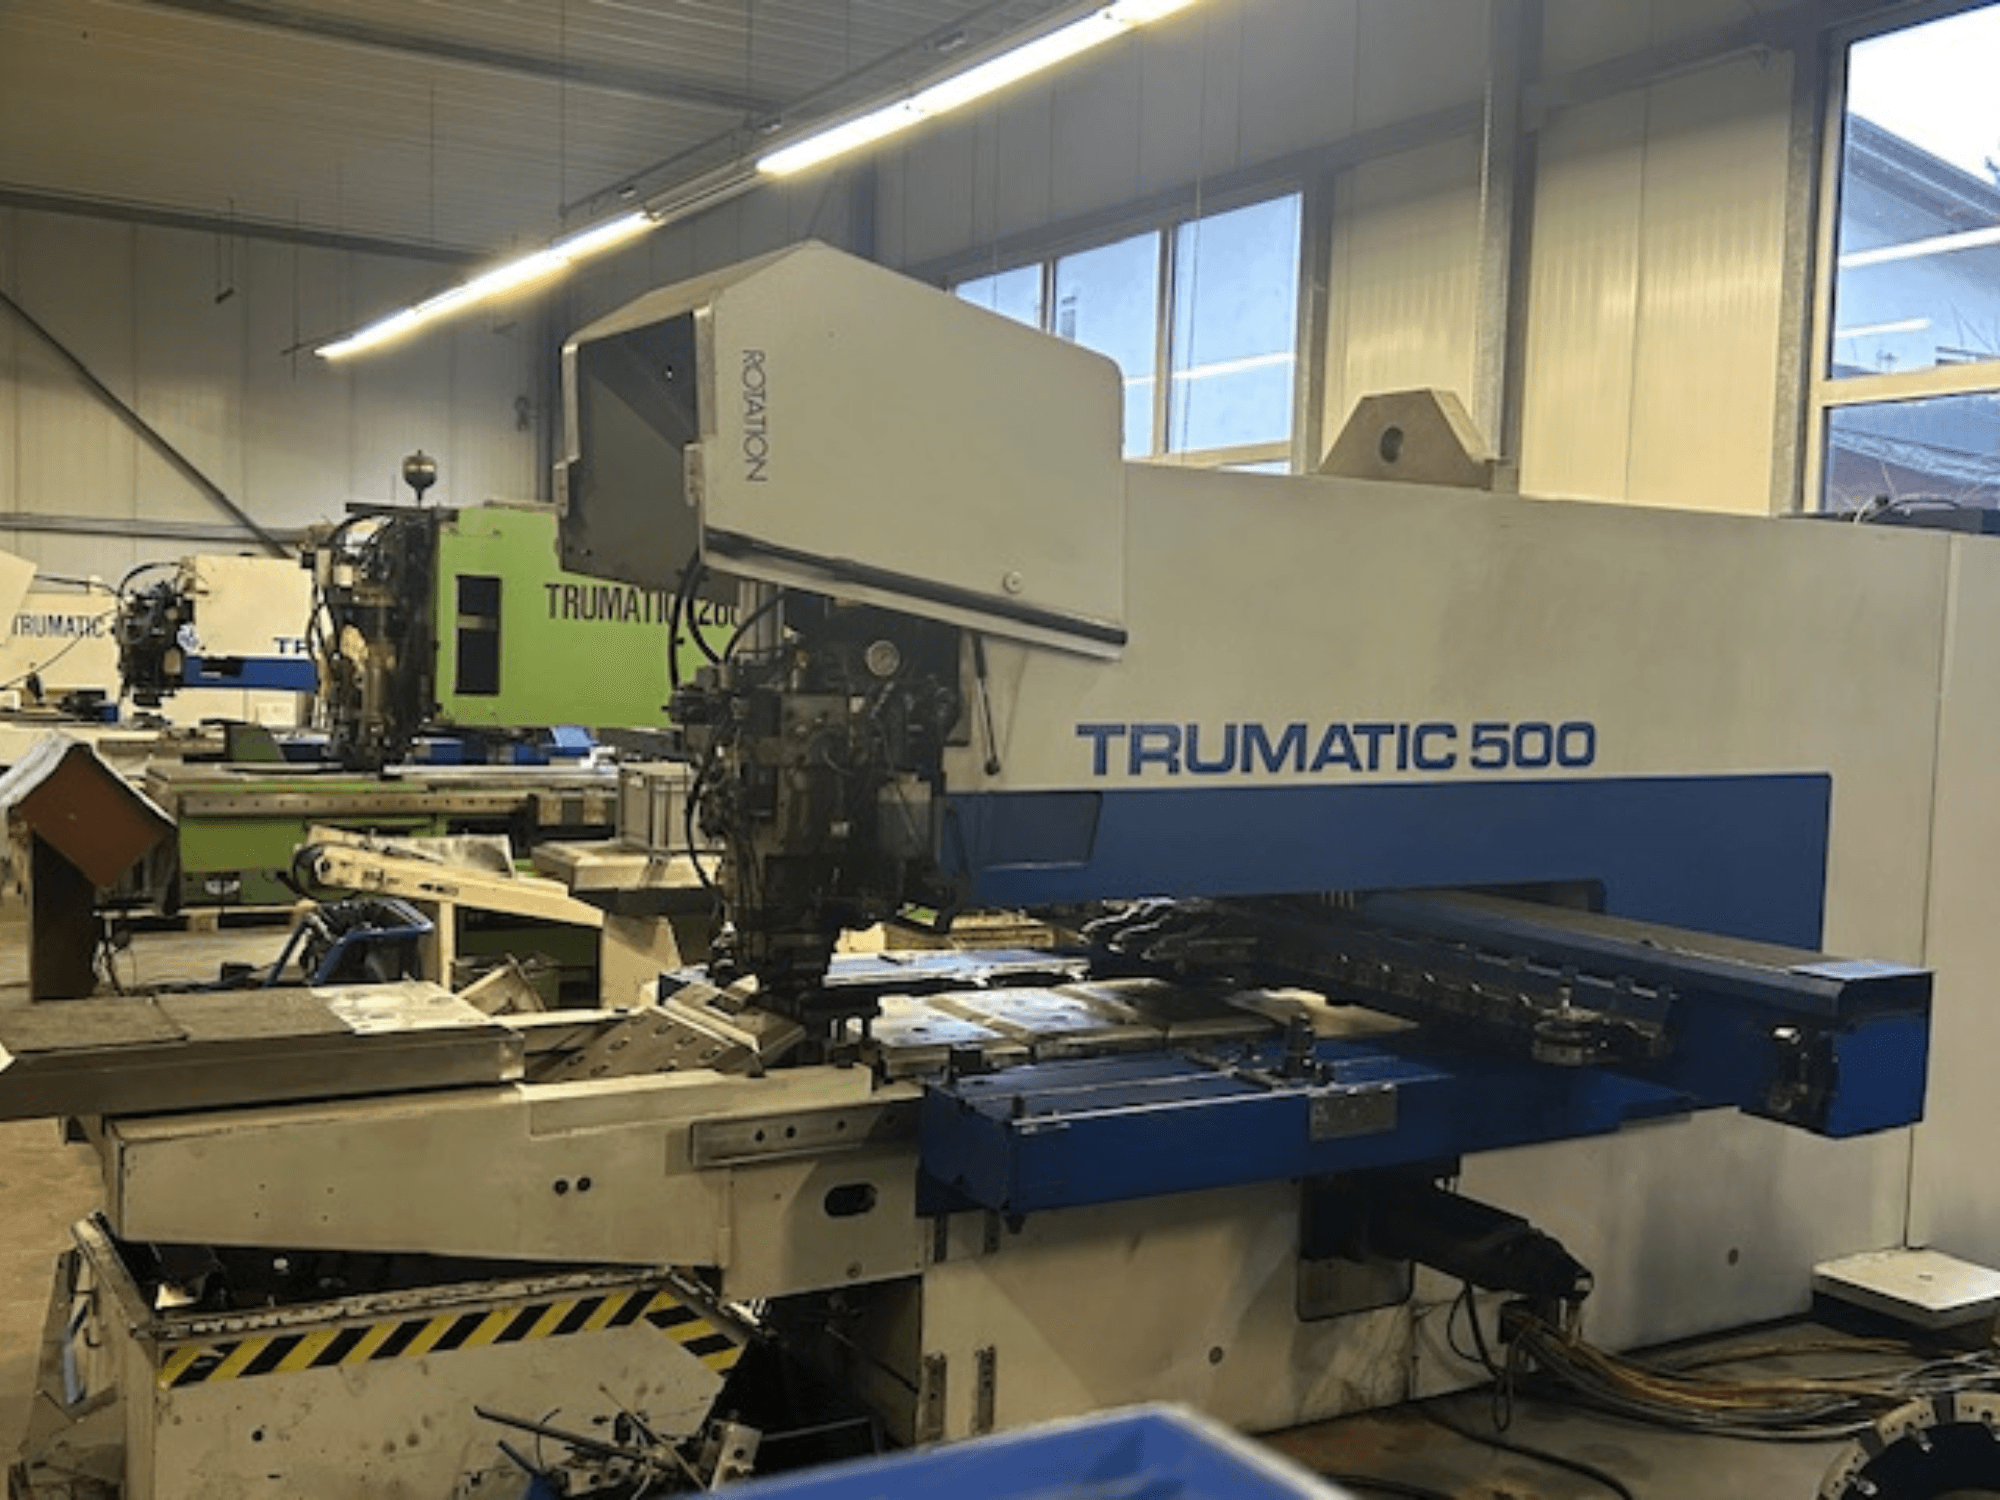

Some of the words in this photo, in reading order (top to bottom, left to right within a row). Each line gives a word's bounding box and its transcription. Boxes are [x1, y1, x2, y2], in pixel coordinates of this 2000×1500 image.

[742, 349, 769, 482] ROTATION
[1075, 722, 1458, 776] TRUMATIC
[1469, 721, 1597, 770] 500
